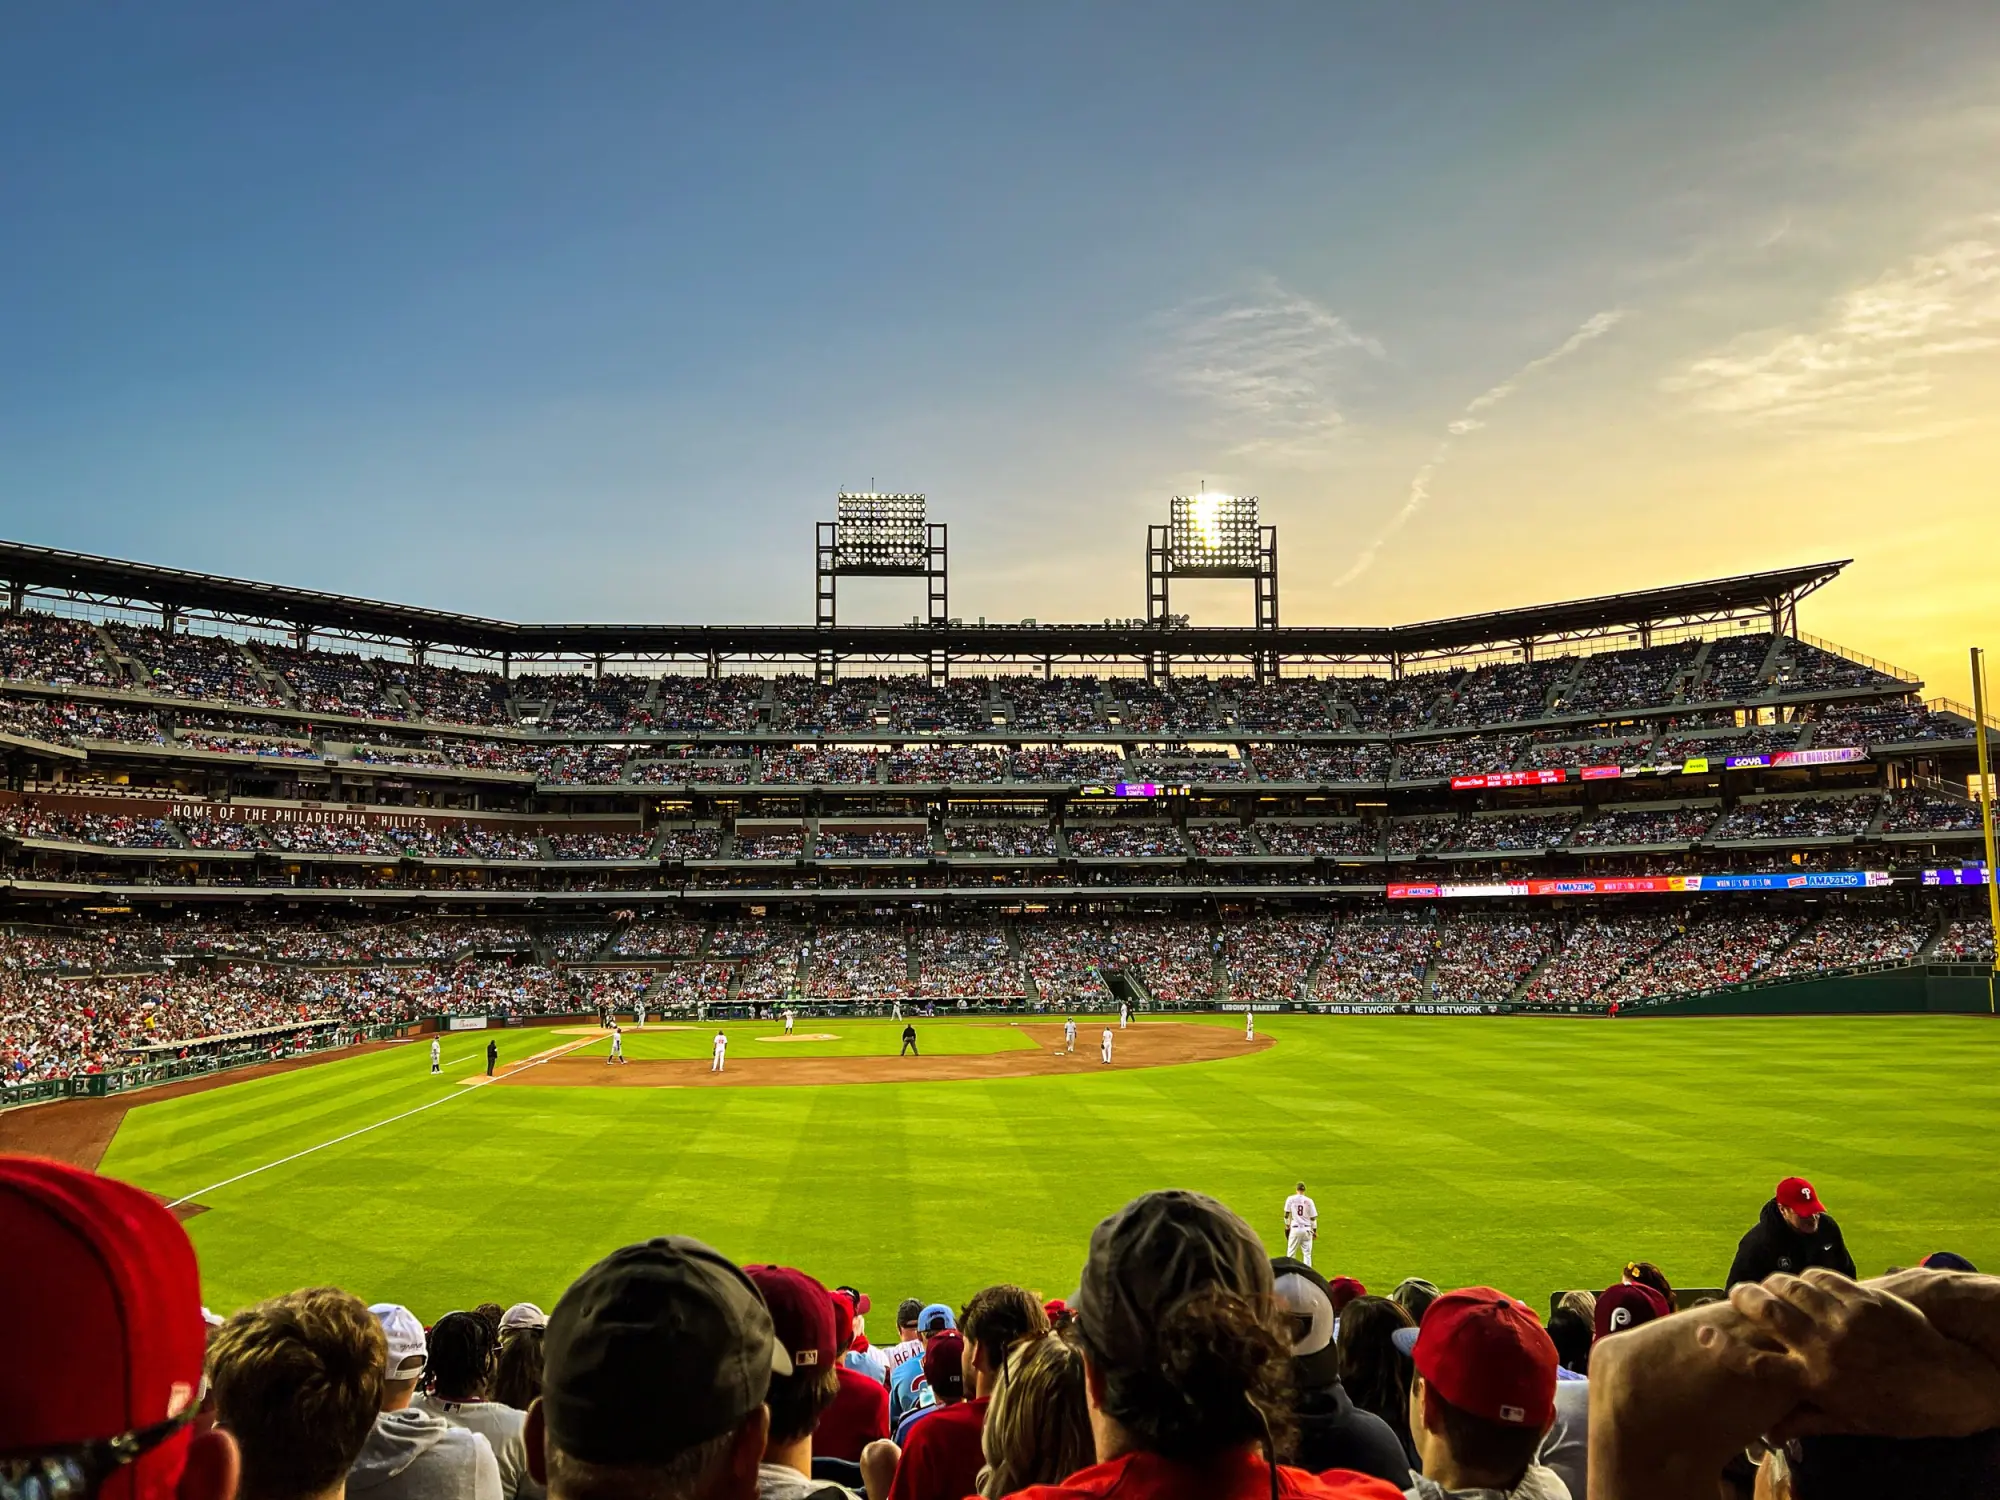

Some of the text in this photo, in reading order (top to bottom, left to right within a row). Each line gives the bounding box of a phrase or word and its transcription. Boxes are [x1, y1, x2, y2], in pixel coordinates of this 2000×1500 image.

[1806, 750, 1852, 763] HOMESTAND
[1734, 757, 1761, 766] GOYA
[173, 804, 425, 828] HOME OF THE PHILADELPHIA HILLIS
[1808, 875, 1858, 886] AMAZING
[1556, 882, 1595, 891] AMAZING
[1252, 1004, 1280, 1012] BAKERY
[1331, 1005, 1350, 1014] MLB
[1352, 1005, 1395, 1014] NETWORK
[1415, 1005, 1435, 1014] MLB
[1437, 1005, 1482, 1014] NETWORK
[1297, 1205, 1304, 1217] 8
